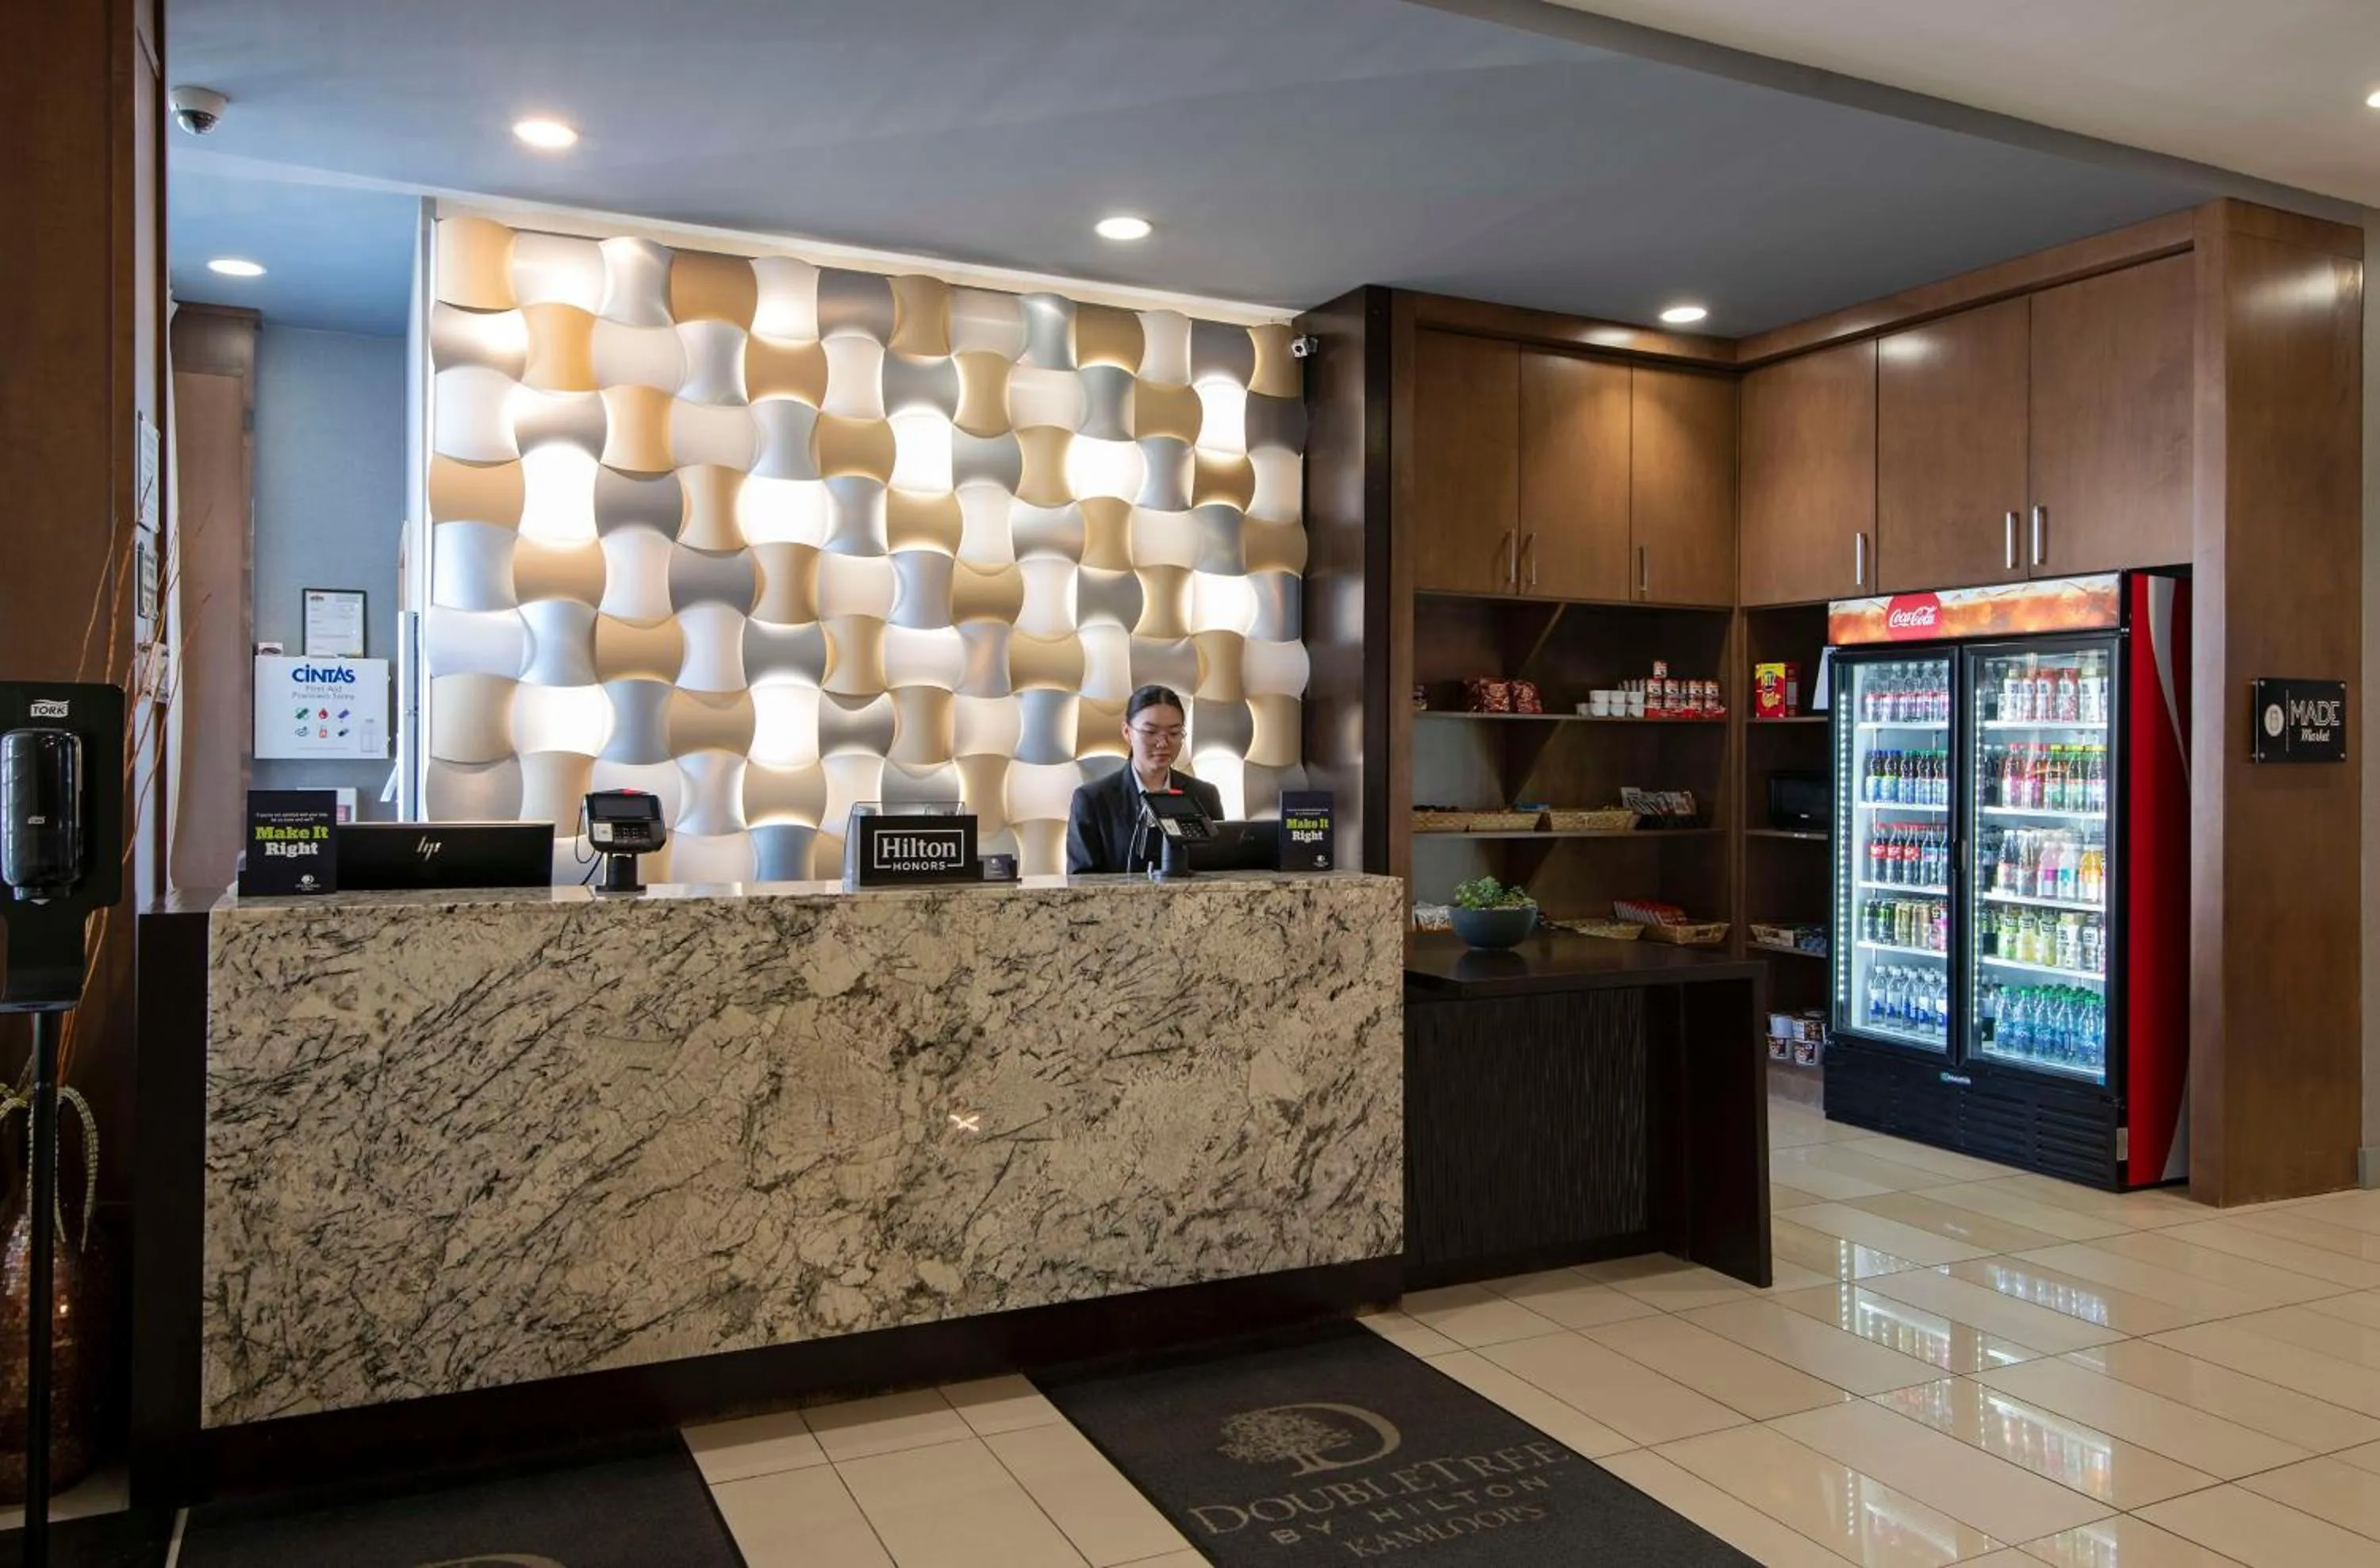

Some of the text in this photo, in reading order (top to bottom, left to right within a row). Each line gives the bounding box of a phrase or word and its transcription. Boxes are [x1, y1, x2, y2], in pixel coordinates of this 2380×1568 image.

[33, 705, 66, 715] TORK
[2290, 699, 2340, 726] MADE
[255, 825, 328, 839] Make It
[1292, 831, 1323, 844] Right
[265, 842, 318, 858] Right
[881, 837, 957, 859] Hilton
[892, 861, 946, 871] HONORS
[1271, 1475, 1551, 1544] BY HILTON
[1342, 1503, 1547, 1558] KAMLOOPS
